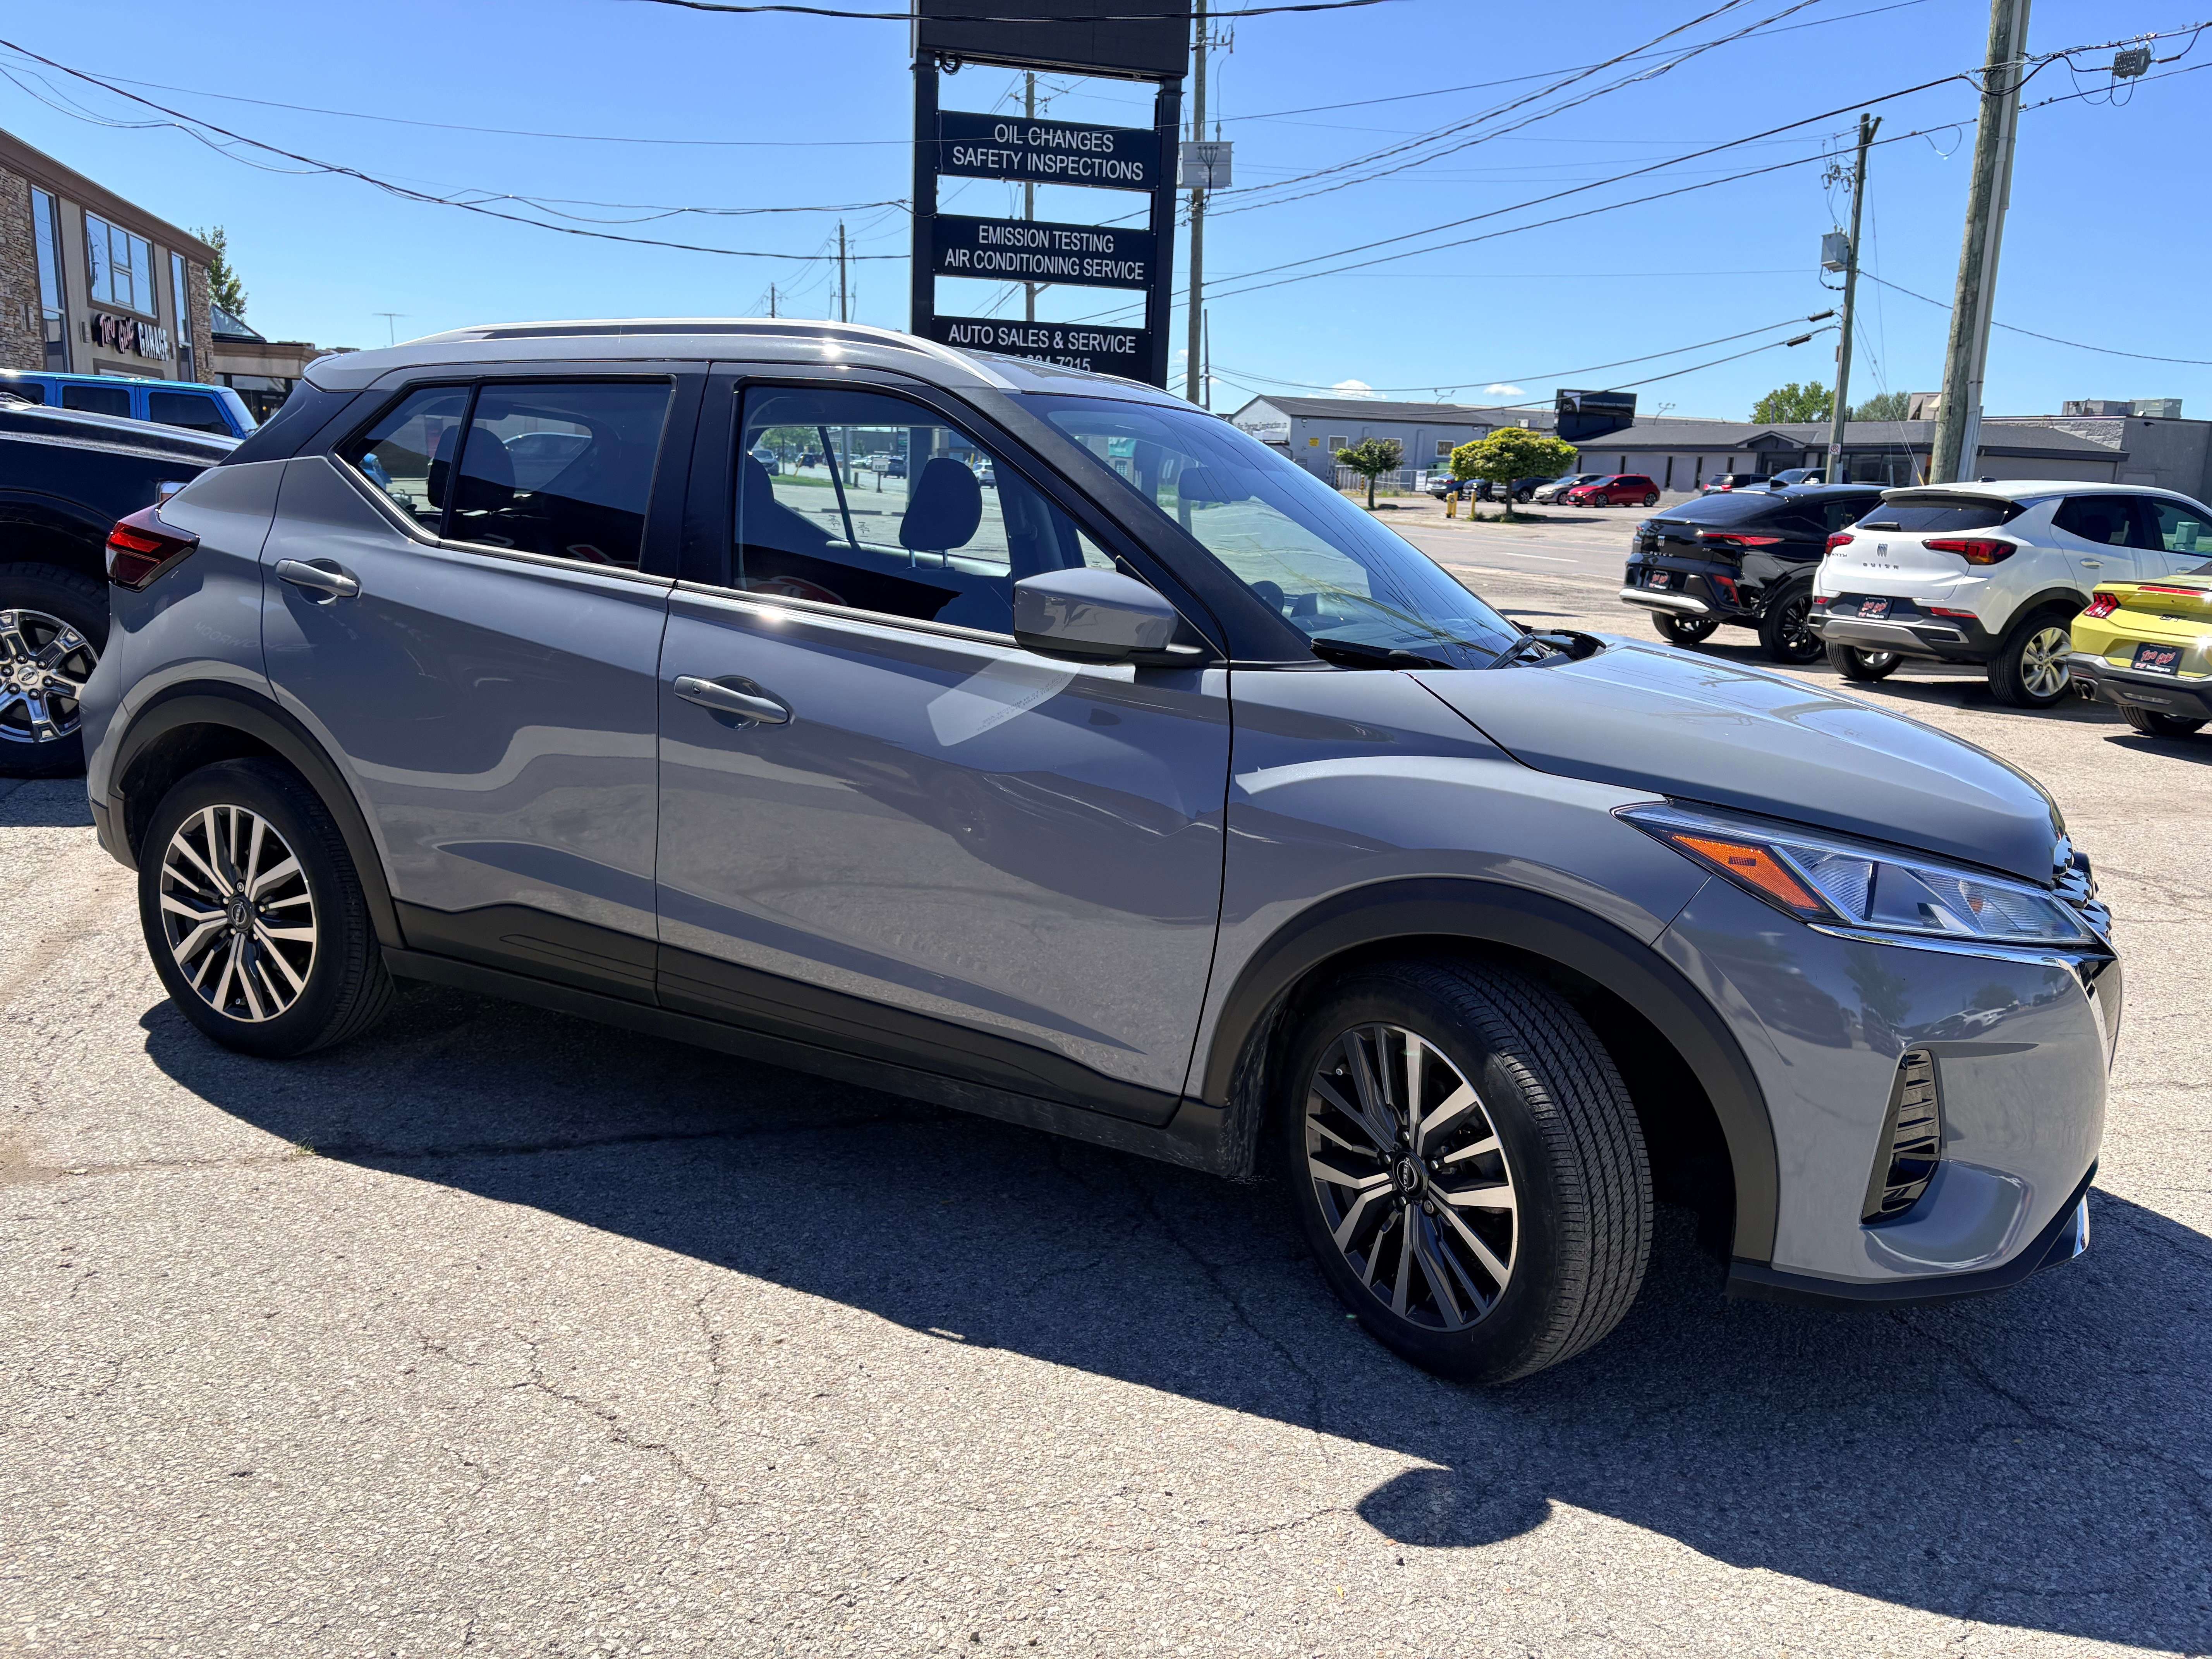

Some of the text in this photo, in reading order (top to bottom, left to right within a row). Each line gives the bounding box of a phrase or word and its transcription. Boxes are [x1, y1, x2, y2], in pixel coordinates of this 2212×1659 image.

[994, 124, 1113, 152] OIL CHANGES
[953, 146, 1143, 180] SAFETY INSPECTIONS
[979, 225, 1114, 253] EMISSION TESTING
[945, 249, 1144, 280] AIR CONDITIONING SERVICE
[138, 322, 169, 361] GARAGE
[948, 324, 1136, 354] AUTO SALES & SERVICE
